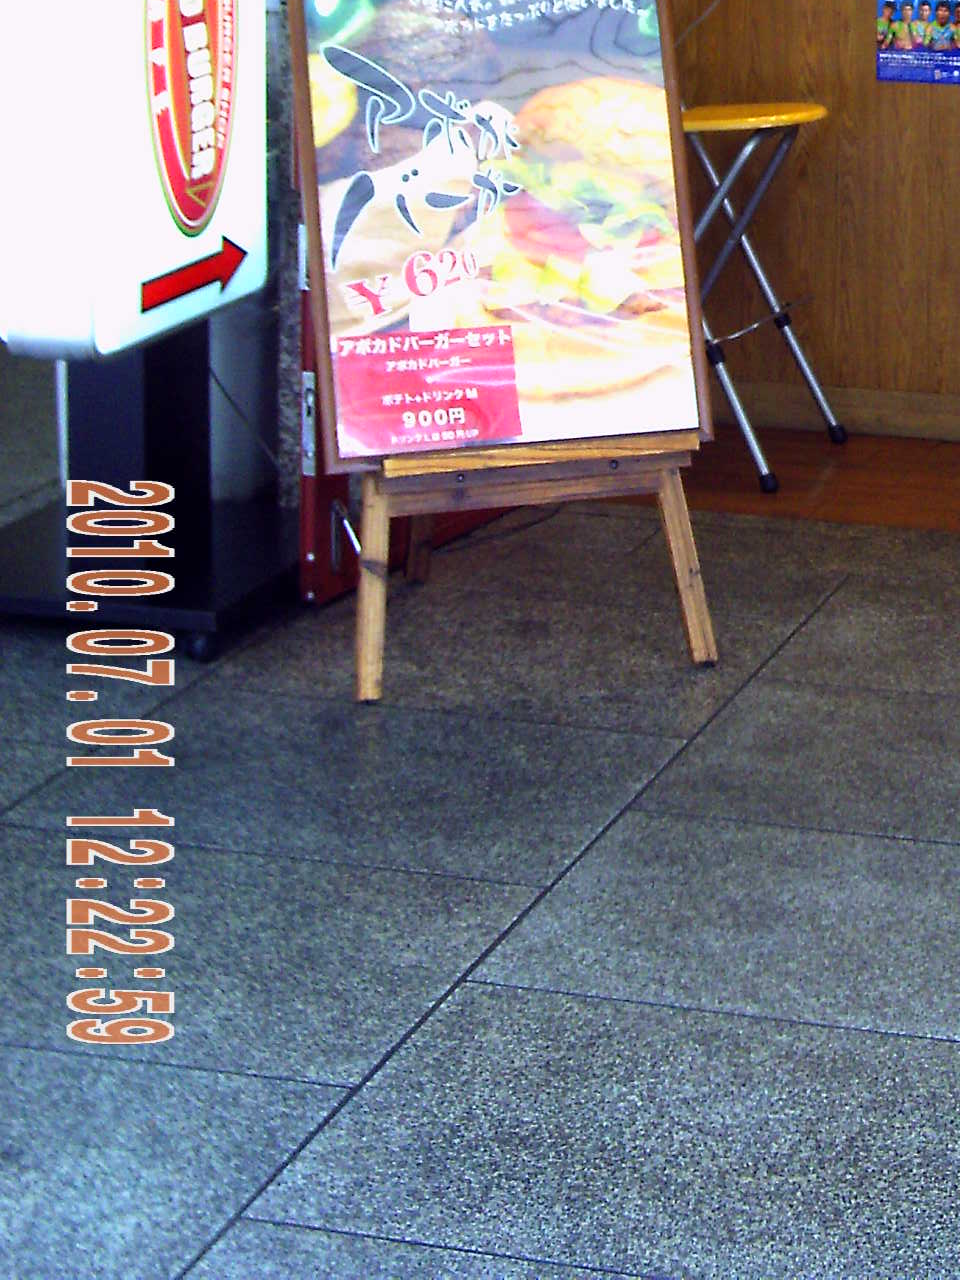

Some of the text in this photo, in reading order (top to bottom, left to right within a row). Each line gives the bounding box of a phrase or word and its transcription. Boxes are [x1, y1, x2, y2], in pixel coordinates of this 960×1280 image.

[181, 21, 216, 180] BURGER
[339, 328, 511, 356] アボカドバーガーセット
[402, 407, 465, 429] 900円
